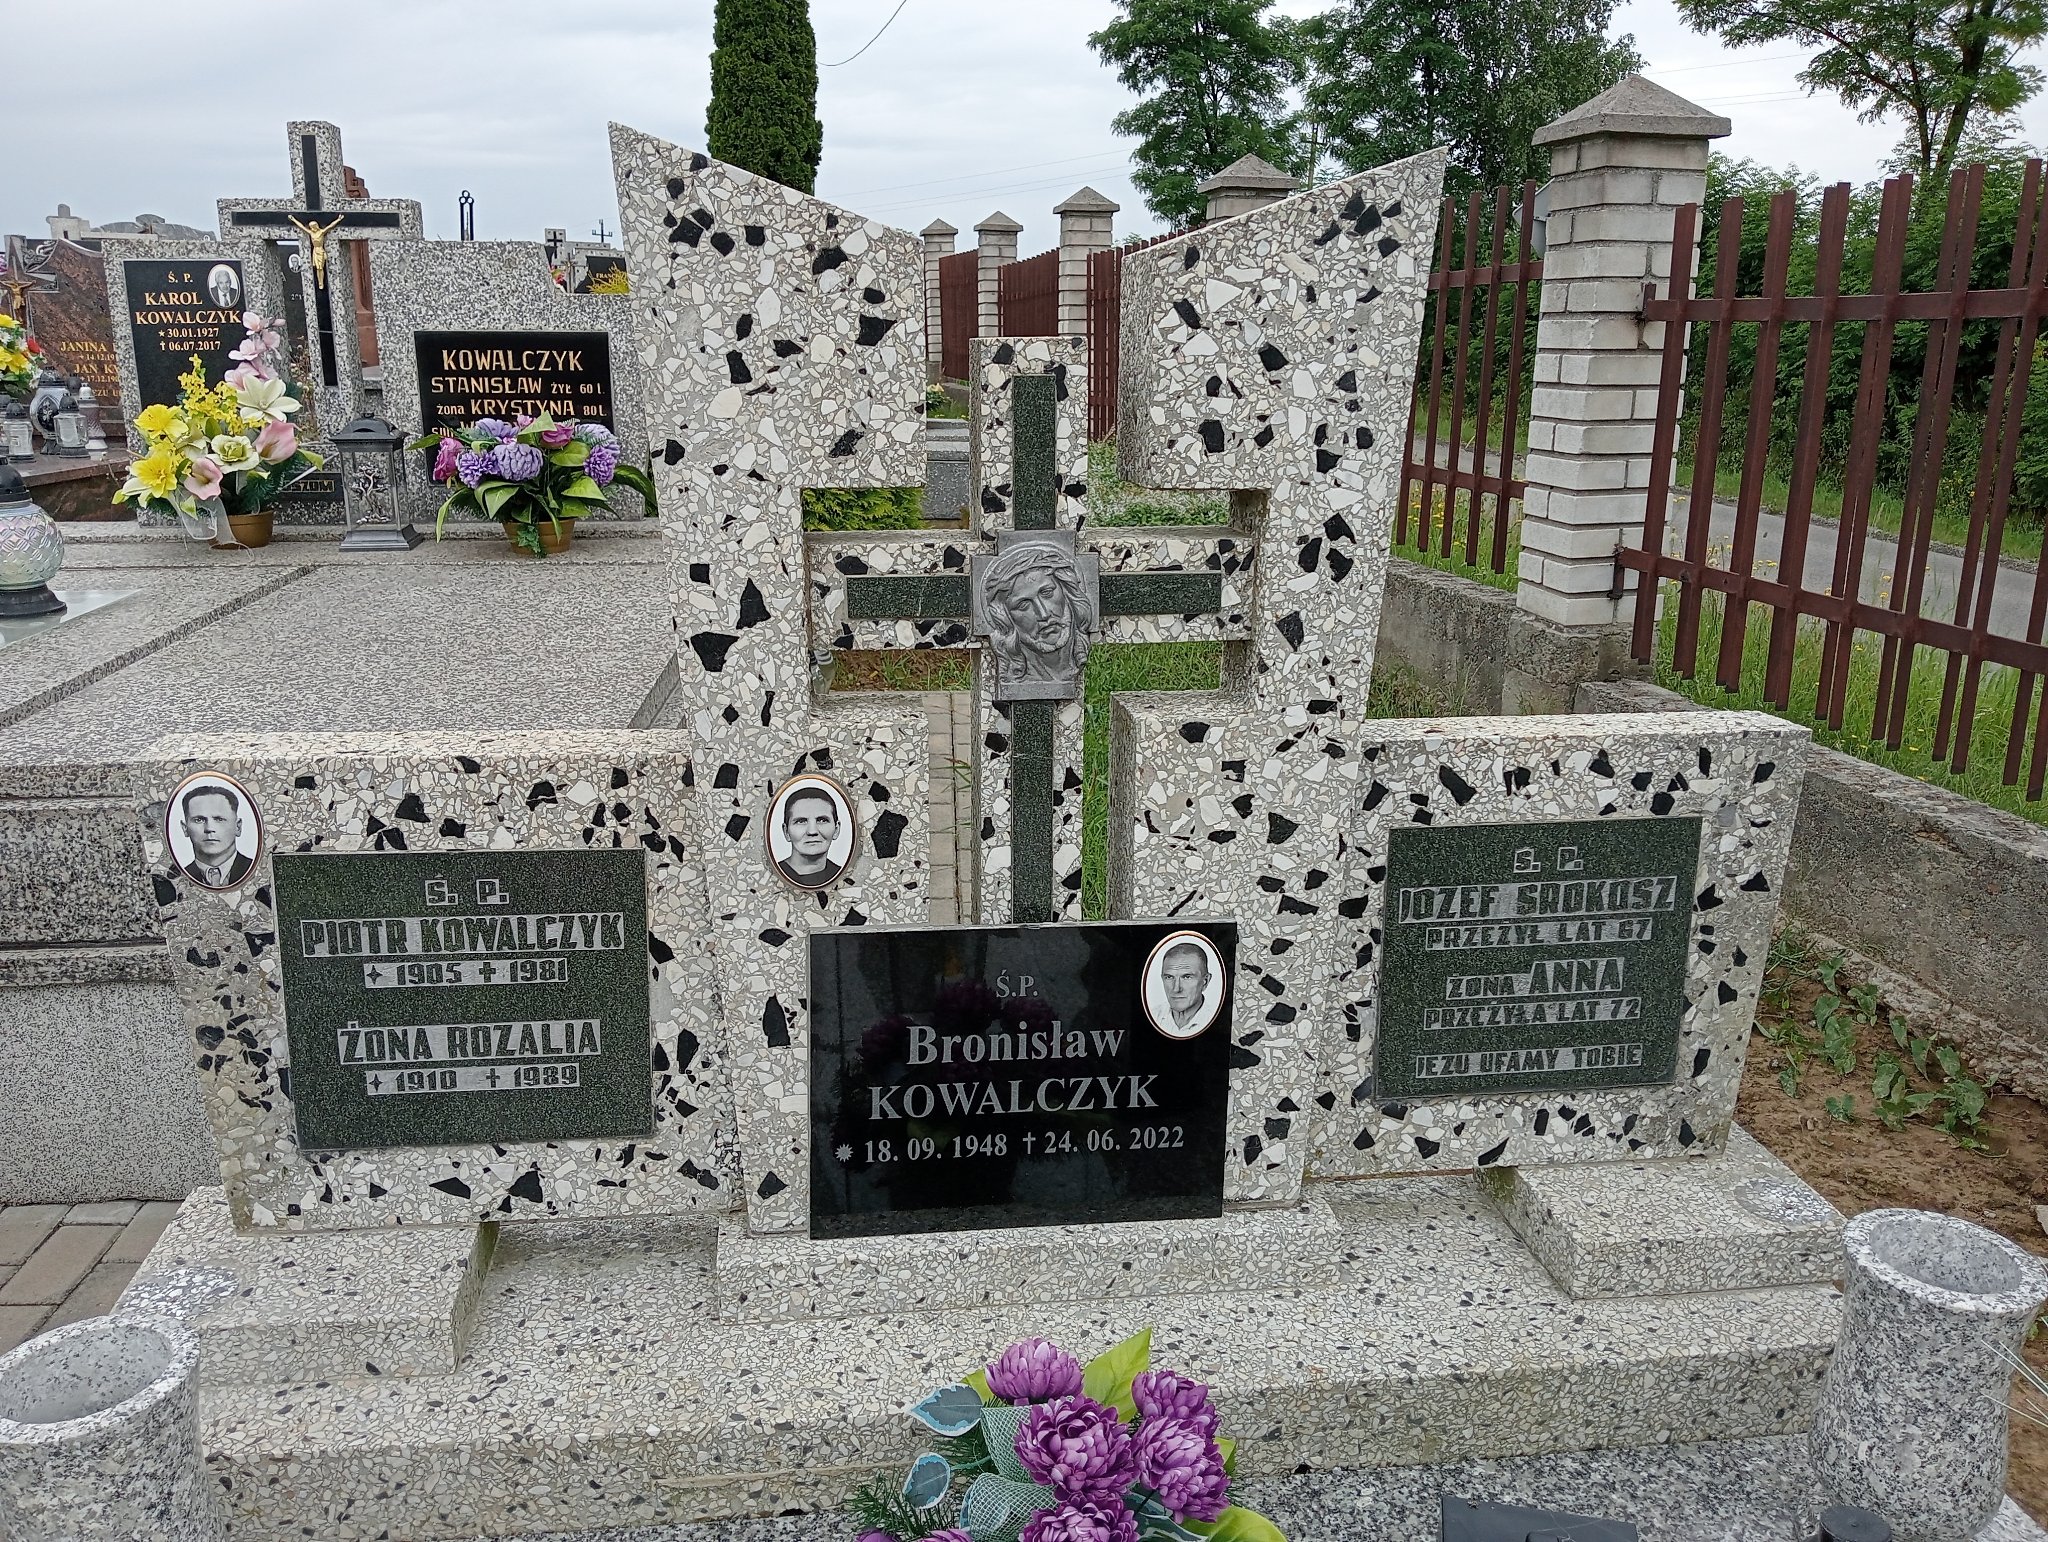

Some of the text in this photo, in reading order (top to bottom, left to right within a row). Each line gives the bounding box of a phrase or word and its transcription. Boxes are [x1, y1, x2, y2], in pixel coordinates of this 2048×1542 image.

[183, 273, 193, 282] P.
[145, 292, 202, 305] KAROL
[135, 310, 241, 324] KOWALCZYK
[168, 328, 219, 338] 30.01.1927
[61, 341, 107, 351] JANINA
[169, 341, 221, 351] 06.07.2017
[74, 363, 98, 373] JAN
[442, 349, 583, 371] KOWALCZYK
[431, 376, 542, 394] STANISŁAW
[580, 383, 593, 394] 60
[437, 404, 465, 415] żona
[471, 399, 576, 416] KRYSTYNA
[583, 405, 597, 415] 80
[478, 879, 509, 905] P.
[303, 913, 624, 955] PIOTR KOWALCZYK
[1557, 921, 1606, 942] LAT
[1618, 919, 1651, 940] 67
[396, 960, 566, 985] 1905 1981
[995, 969, 1039, 998] Ś.P.
[1529, 959, 1622, 994] ANNA
[1556, 1001, 1600, 1021] LAT
[1610, 998, 1640, 1019] 72
[339, 1020, 599, 1063] ŻONA ROZALIA
[906, 1021, 1125, 1065] Bronisław
[1417, 1044, 1642, 1077] JEZU UFAMY TOBIE
[395, 1065, 578, 1092] 1910 1989
[868, 1074, 1159, 1120] KOWALCZYK
[865, 1126, 1184, 1163] 18. 09. 1948 24. 06. 2022
